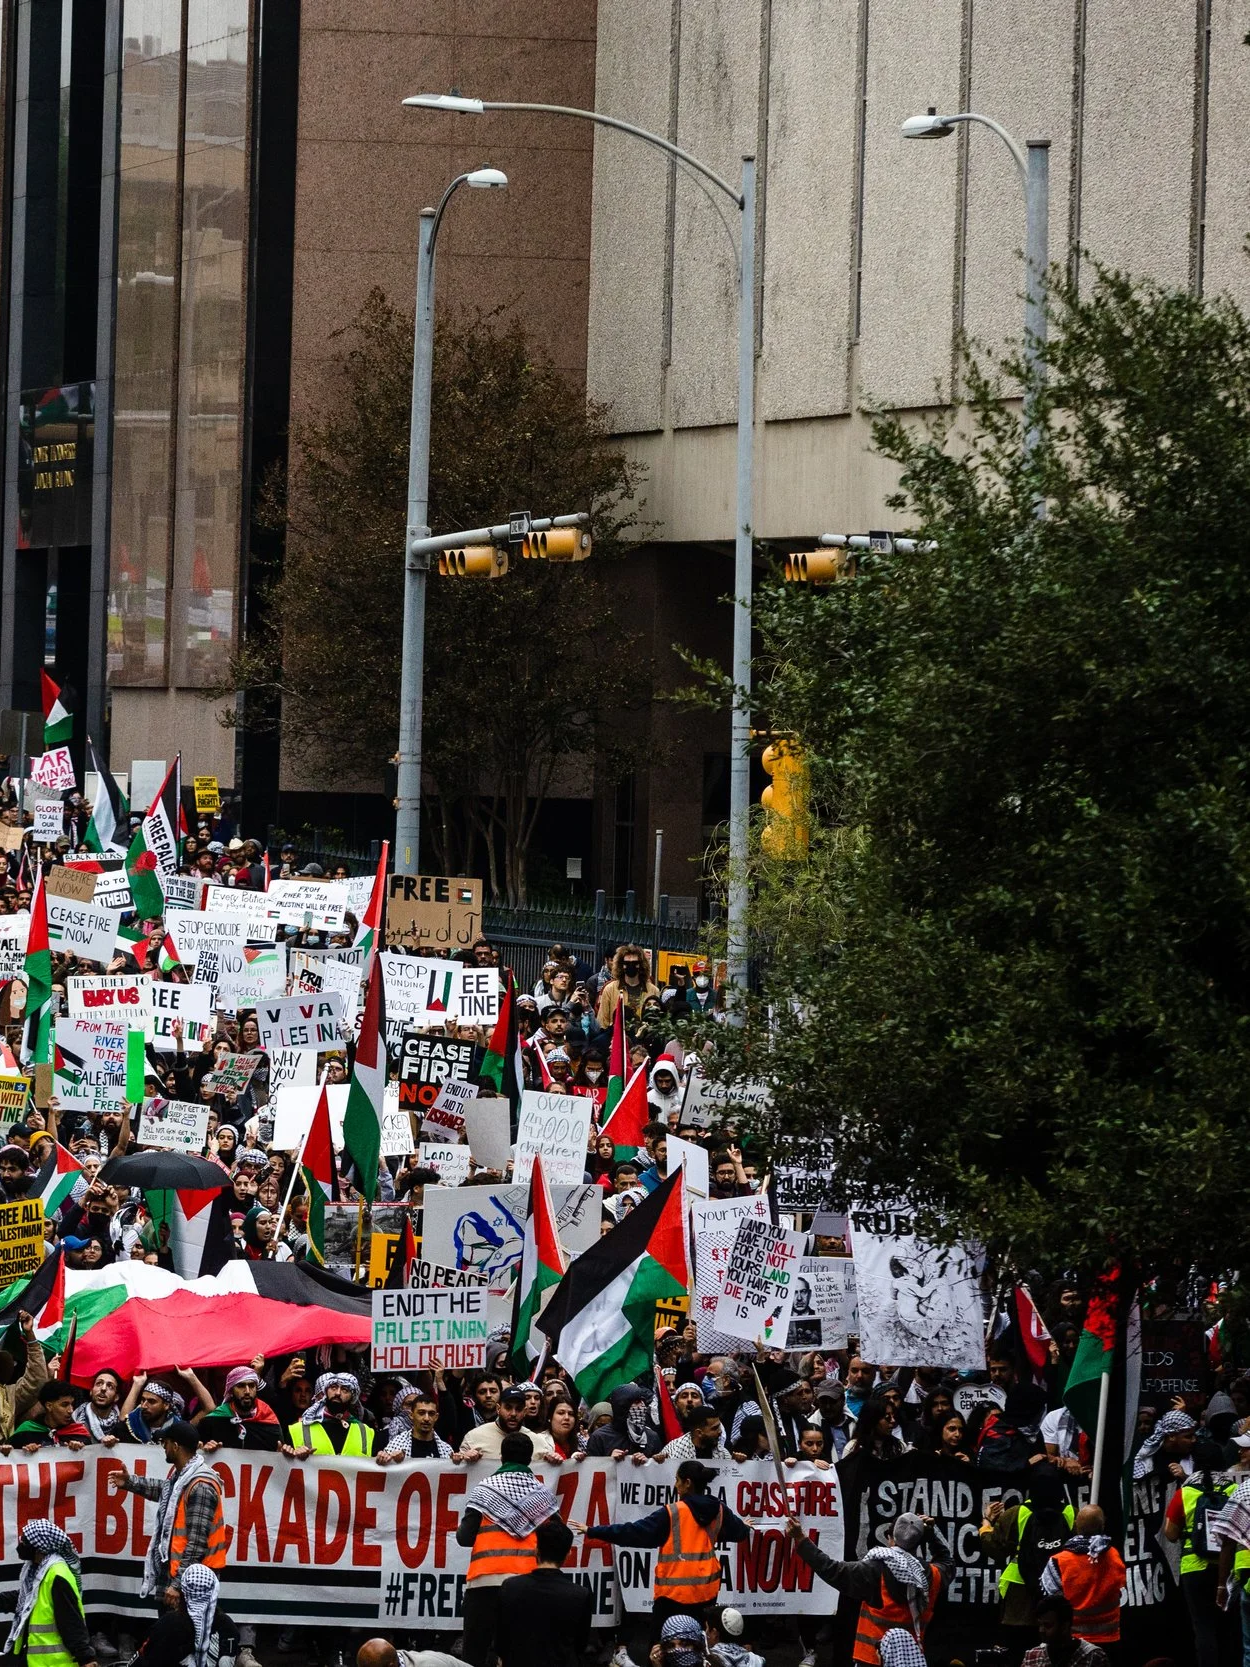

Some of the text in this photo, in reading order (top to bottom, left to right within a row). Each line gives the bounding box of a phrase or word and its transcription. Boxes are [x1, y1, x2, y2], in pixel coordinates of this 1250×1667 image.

[55, 882, 82, 895] NOW
[212, 891, 238, 906] Every
[390, 876, 450, 903] FREE
[51, 907, 111, 932] CEASE FIRE
[178, 920, 241, 937] STOP GENOCIDE
[65, 924, 93, 945] NOW
[178, 937, 193, 950] END
[221, 952, 242, 974] NO
[338, 951, 362, 965] NOT
[196, 967, 218, 982] END
[387, 961, 427, 979] STOP
[133, 975, 149, 986] TO
[385, 977, 425, 990] FUNDING
[119, 986, 140, 1005] US
[266, 1002, 333, 1024] VIVA
[75, 1021, 125, 1035] FROM THE
[95, 1035, 125, 1050] RIVER
[404, 1038, 471, 1062] CEASE
[92, 1048, 126, 1063] TO THE
[272, 1050, 302, 1068] WHY
[104, 1061, 124, 1072] SEA
[272, 1066, 295, 1081] YOU
[401, 1055, 469, 1083] FIRE
[73, 1069, 127, 1087] PALESTINE
[0, 1092, 24, 1105] WITH
[62, 1085, 109, 1098] WILL BE
[446, 1083, 460, 1094] END
[700, 1085, 765, 1105] CLEANSING
[93, 1099, 120, 1111] FREE
[538, 1093, 578, 1115] over
[524, 1112, 585, 1143] 4000
[520, 1141, 581, 1160] children
[22, 1203, 42, 1223] ALL
[698, 1206, 753, 1228] YOUR TAX
[739, 1217, 787, 1241] LAND YOU
[736, 1230, 796, 1259] HAVE TO KILL
[733, 1242, 752, 1260] FOR
[756, 1250, 764, 1263] IS
[766, 1252, 788, 1270] NOT
[411, 1261, 488, 1287] NO PEACE
[730, 1255, 762, 1276] YOURS
[762, 1267, 790, 1285] LAND
[727, 1268, 789, 1299] YOU HAVE TO
[383, 1292, 481, 1317] END THE
[724, 1282, 767, 1309] DIE FOR
[375, 1320, 487, 1343] PALESTINIAN
[374, 1343, 485, 1370] HOLOCAUST
[620, 1480, 839, 1518] WE CEASEFIRE
[876, 1478, 974, 1518] STAND
[395, 1472, 467, 1569] OF
